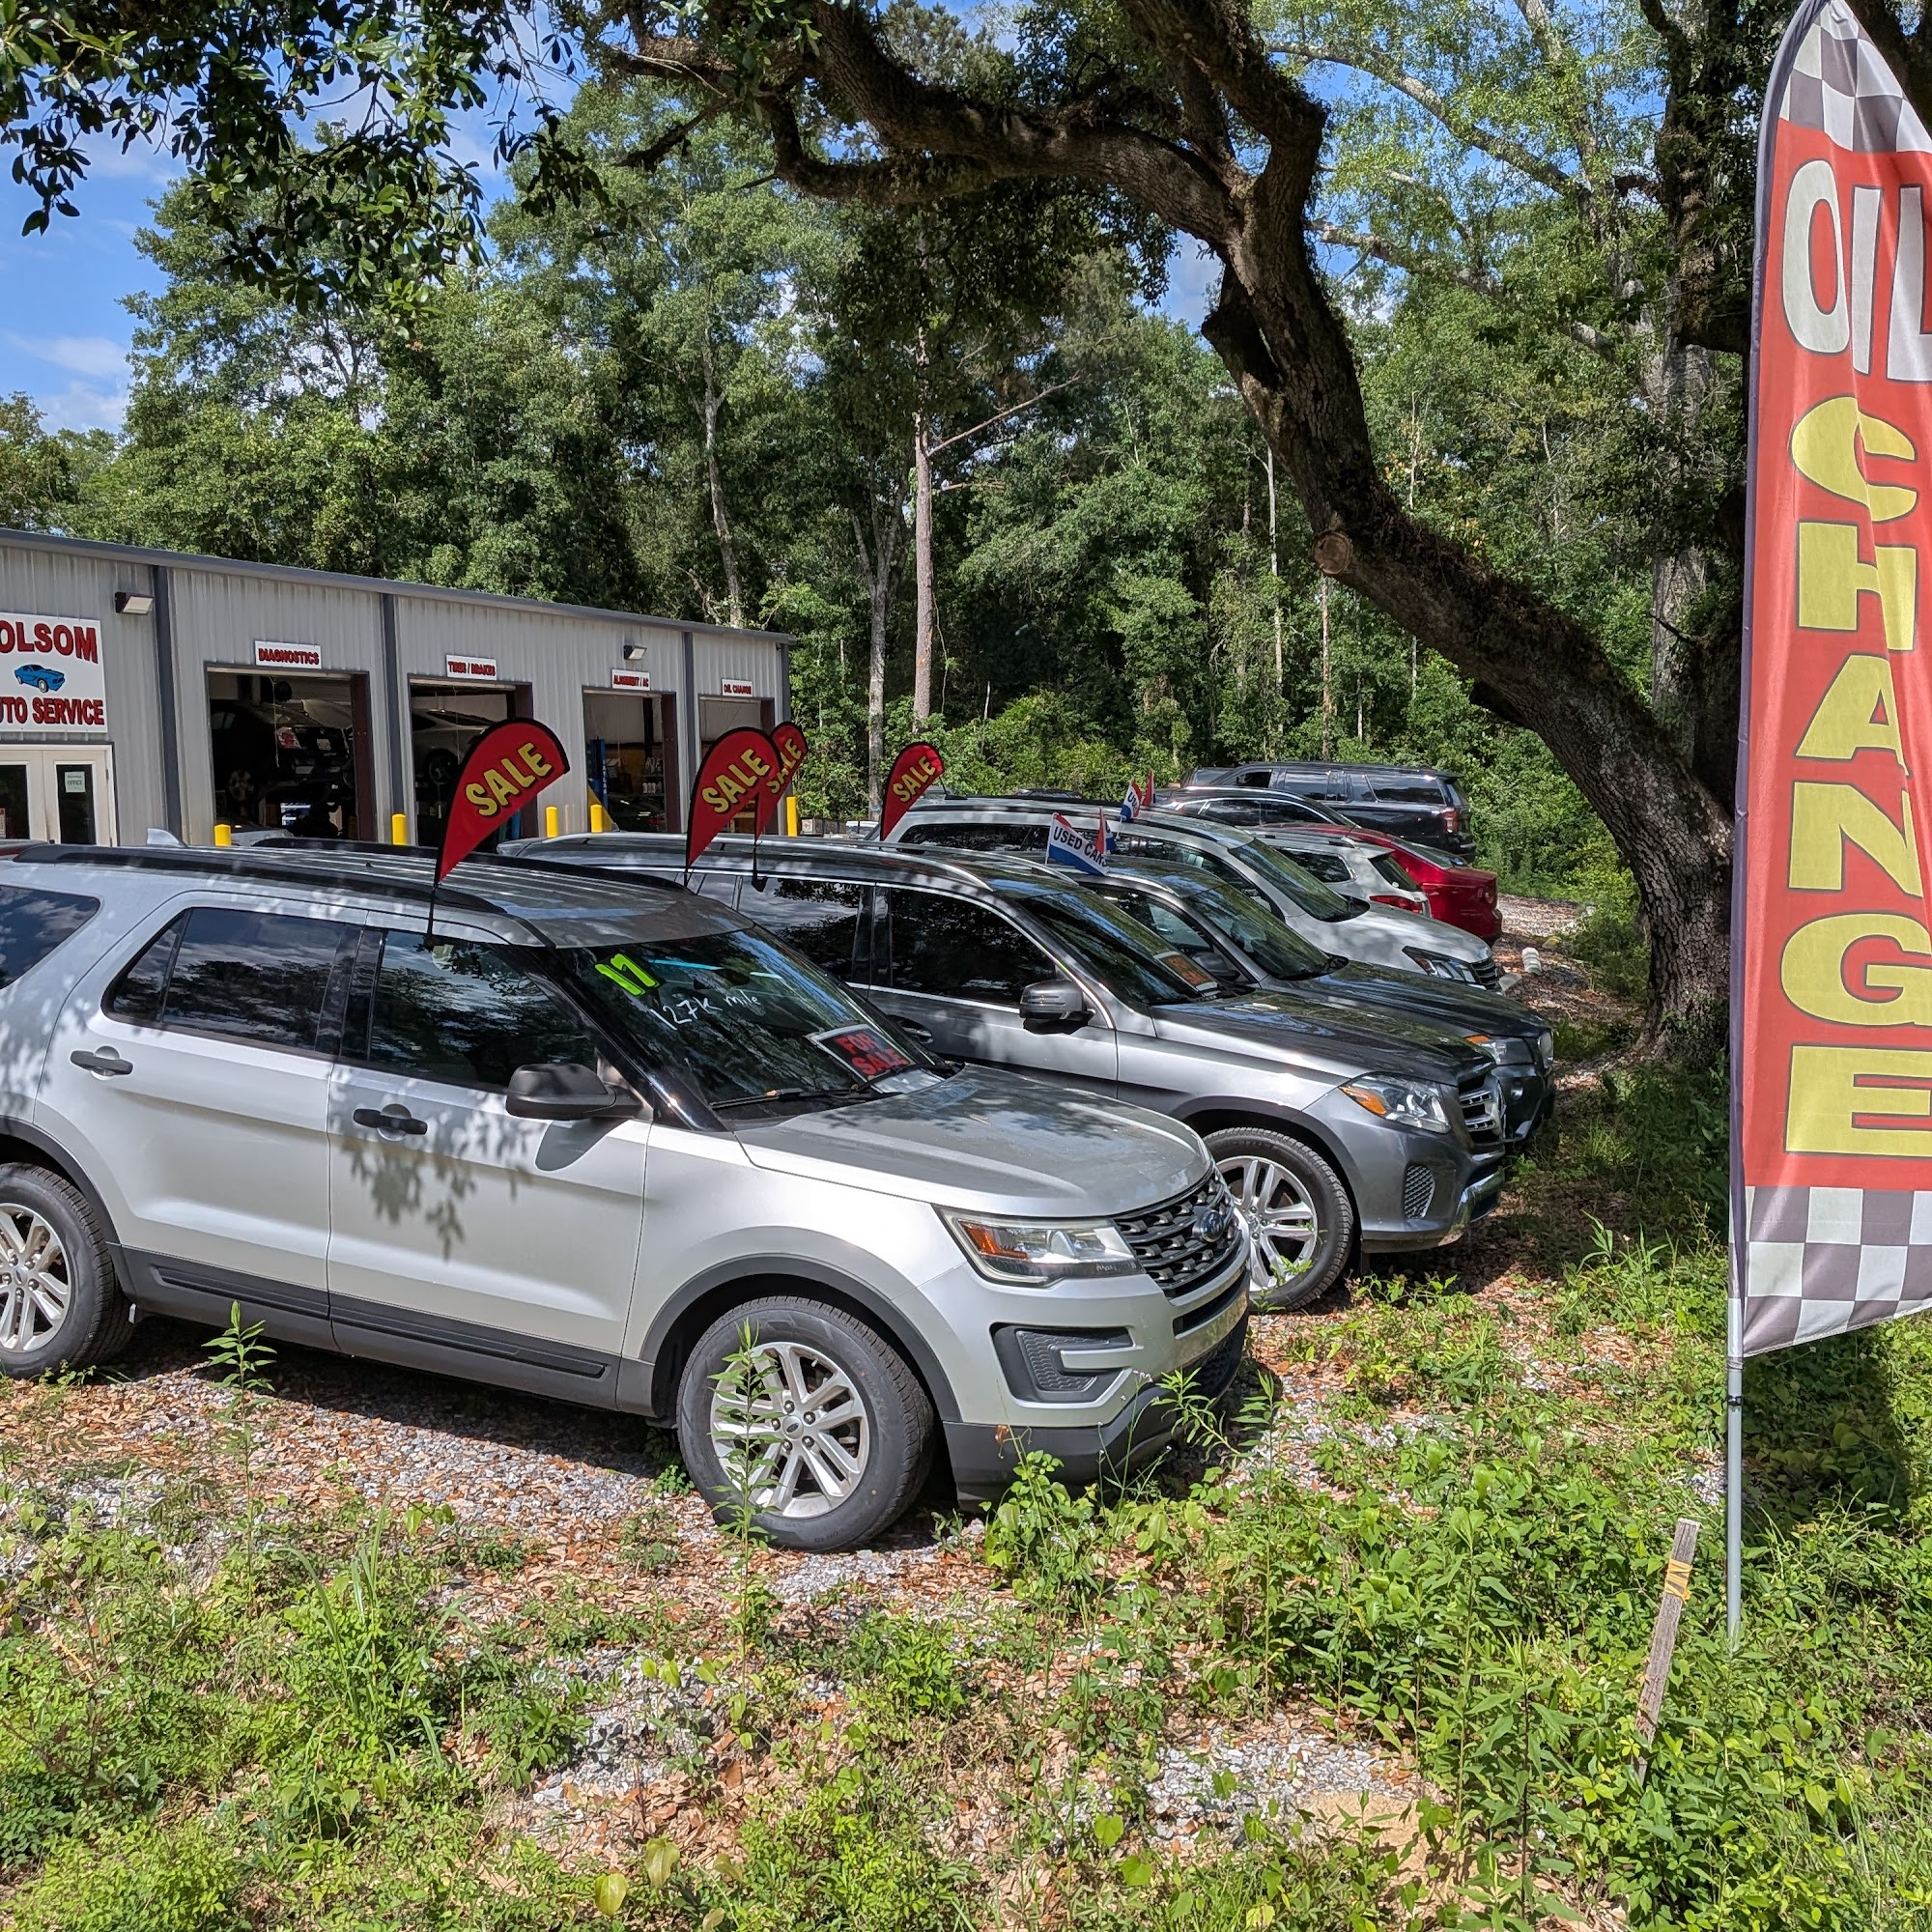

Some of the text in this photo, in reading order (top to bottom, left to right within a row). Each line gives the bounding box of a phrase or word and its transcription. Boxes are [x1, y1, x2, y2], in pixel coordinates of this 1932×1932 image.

[1782, 158, 1932, 383] OIL
[258, 647, 320, 666] DIAGNOSTICS
[32, 696, 105, 725] SERVICE
[465, 742, 553, 816] SALE
[701, 749, 771, 813] SALE
[893, 755, 936, 803] SALE
[1780, 395, 1932, 1158] CHANGE
[1053, 826, 1083, 851] USED
[836, 1032, 876, 1055] FOR
[851, 1048, 911, 1075] SALE
